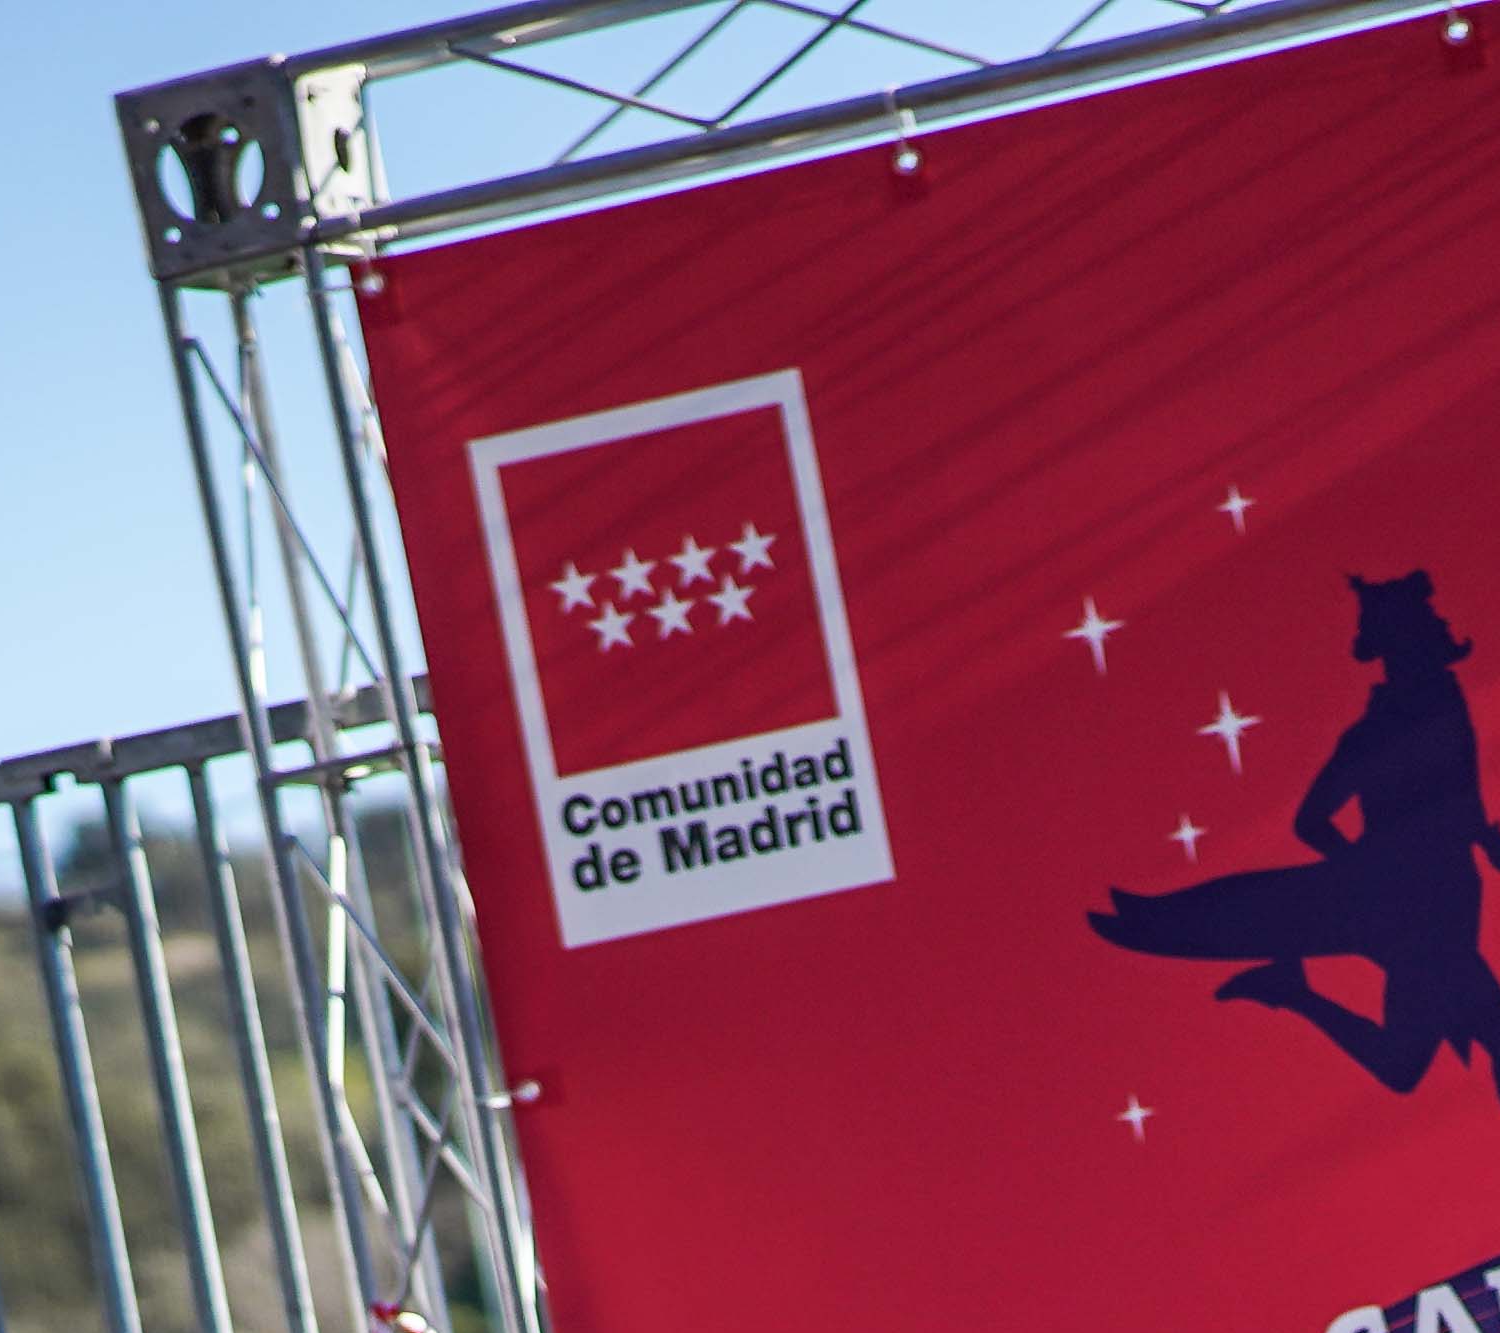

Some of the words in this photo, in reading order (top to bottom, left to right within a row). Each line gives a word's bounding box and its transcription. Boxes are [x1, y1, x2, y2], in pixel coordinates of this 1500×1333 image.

[561, 737, 855, 837] Comunidad
[572, 842, 642, 892] de
[658, 790, 863, 875] Madrid
